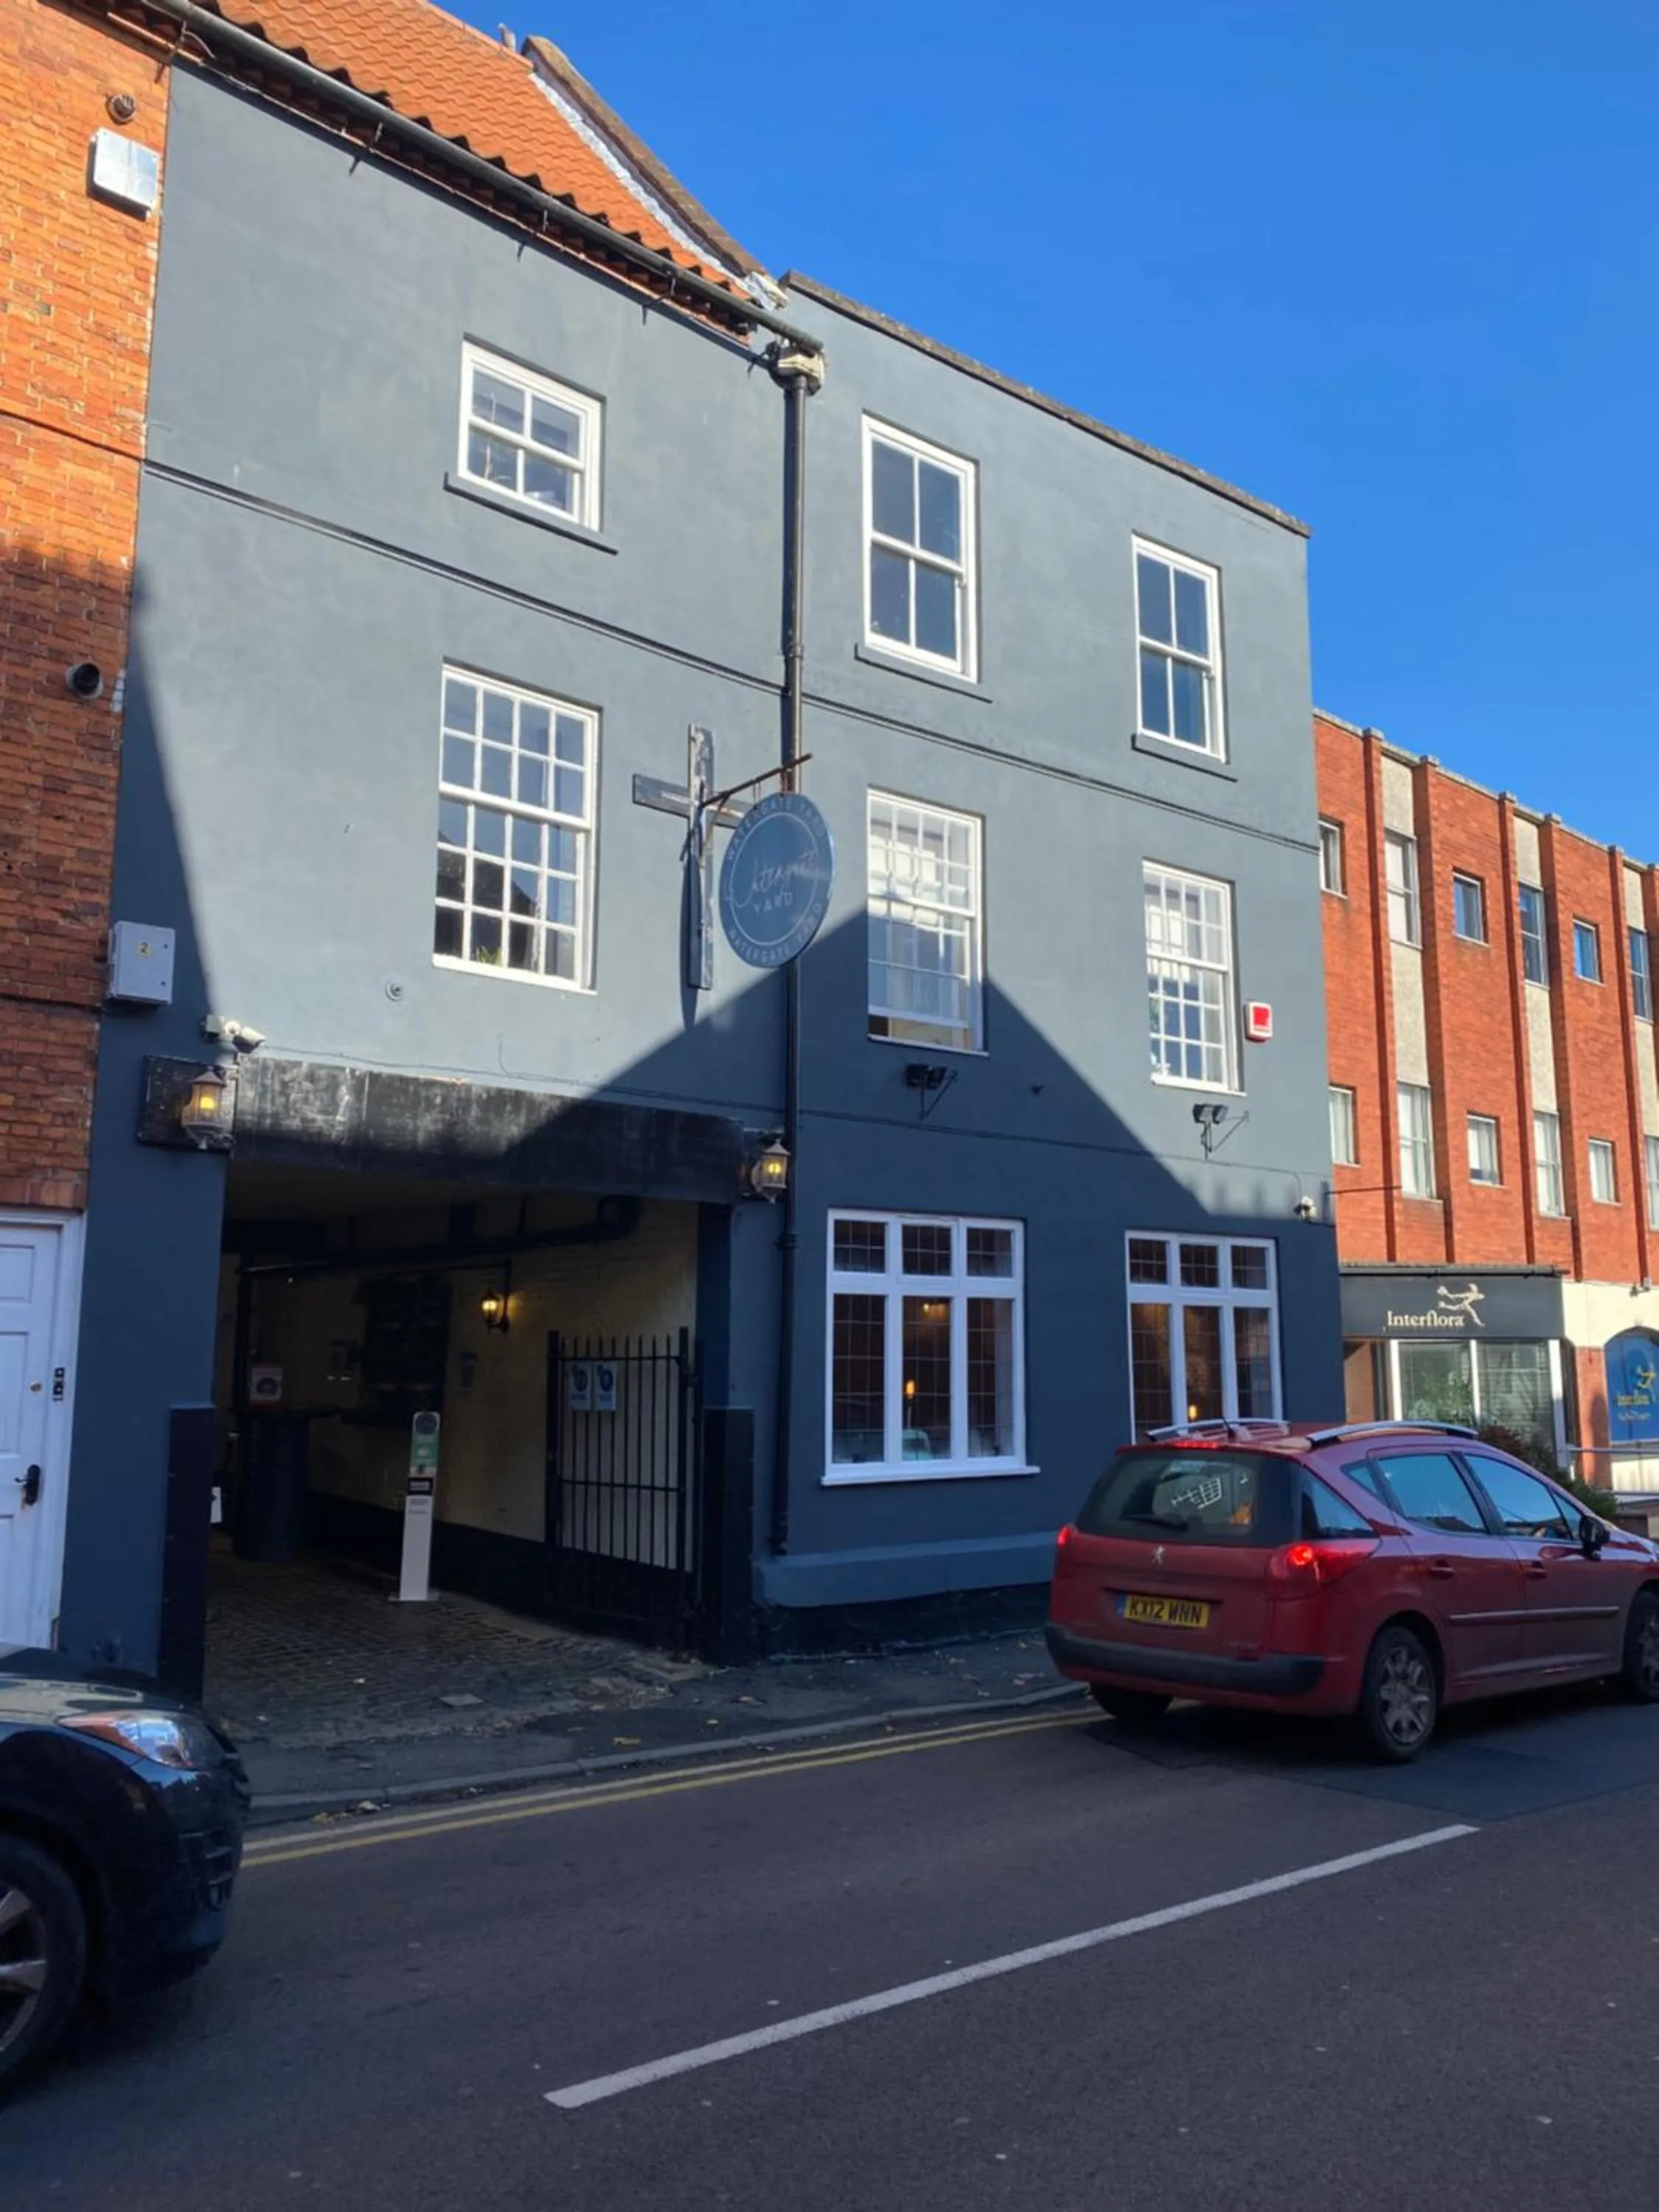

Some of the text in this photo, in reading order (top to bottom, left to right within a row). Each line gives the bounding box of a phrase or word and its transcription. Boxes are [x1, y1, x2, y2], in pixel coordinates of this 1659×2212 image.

[752, 891, 793, 916] YARD
[1386, 1309, 1465, 1328] Interflora
[1128, 1596, 1203, 1625] KX12 WNN
